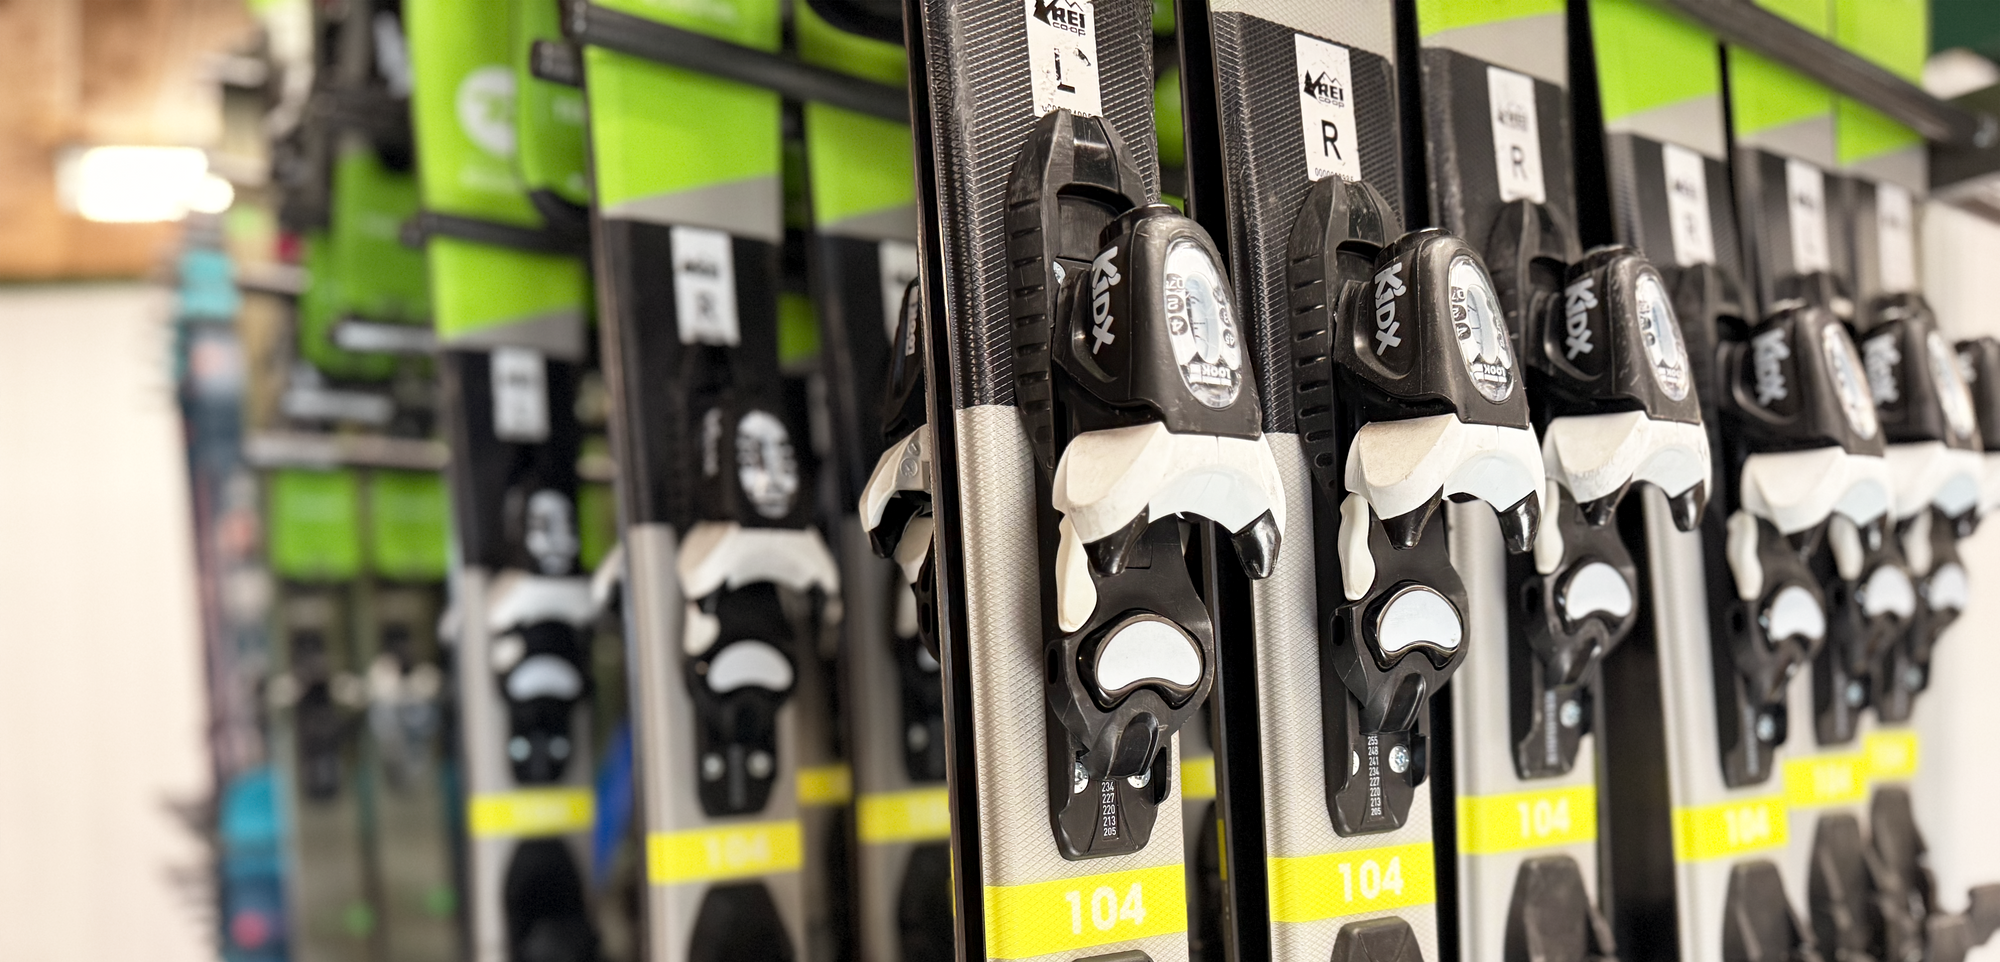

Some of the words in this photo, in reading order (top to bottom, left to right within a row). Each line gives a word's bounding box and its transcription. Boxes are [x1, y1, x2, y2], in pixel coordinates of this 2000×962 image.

[1052, 7, 1085, 28] REI
[1054, 47, 1076, 94] L
[1318, 83, 1344, 101] REI
[1321, 119, 1342, 161] R
[1510, 144, 1529, 181] R
[1203, 364, 1231, 379] LOOK
[1484, 364, 1506, 377] LOOK
[1367, 736, 1379, 746] 255
[1368, 746, 1379, 756] 248
[1369, 757, 1379, 766] 241
[1369, 767, 1380, 776] 234
[1369, 777, 1380, 786] 227
[1101, 782, 1114, 792] 234
[1370, 787, 1381, 797] 220
[1102, 793, 1115, 804] 227
[1370, 798, 1381, 807] 213
[1103, 805, 1116, 815] 220
[1371, 808, 1382, 816] 205
[1103, 816, 1116, 826] 213
[1517, 797, 1571, 839] 104
[1104, 827, 1117, 837] 205
[1338, 856, 1404, 904] 104
[1065, 882, 1147, 935] 104
